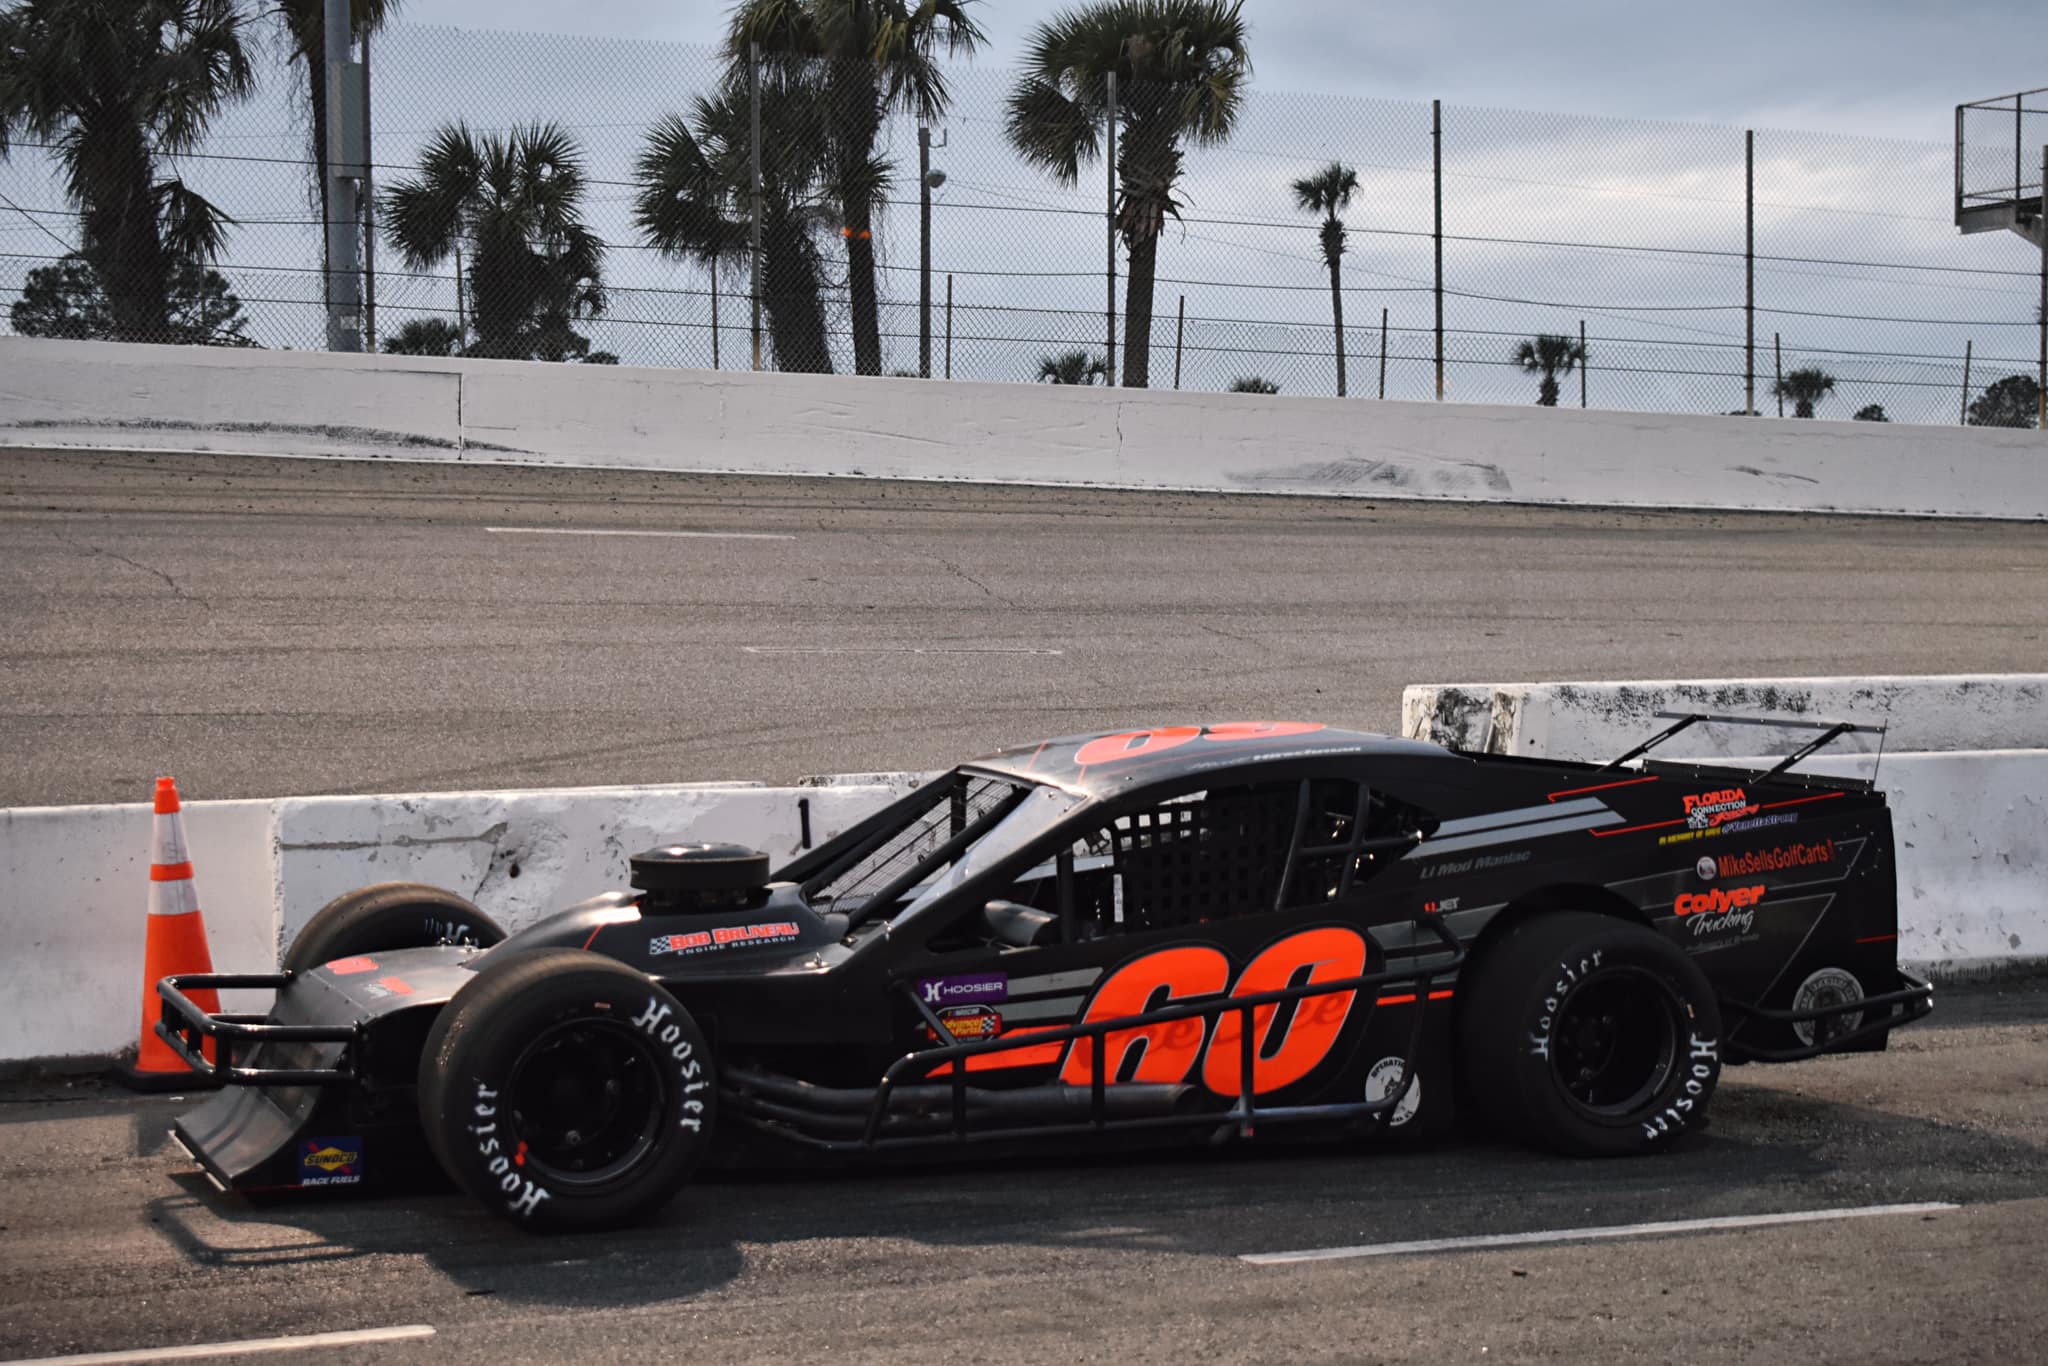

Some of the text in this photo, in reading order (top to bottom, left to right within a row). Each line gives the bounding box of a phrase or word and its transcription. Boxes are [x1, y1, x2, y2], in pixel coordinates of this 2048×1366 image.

[1682, 787, 1746, 814] FLORIDA
[1691, 800, 1747, 816] CONNECTION
[1674, 884, 1766, 917] Colyer
[1686, 905, 1755, 937] Trucking
[670, 932, 711, 951] BOB
[677, 935, 796, 956] ENGINE RESEARCH
[943, 982, 1003, 994] HOOSIER
[1058, 926, 1368, 1098] 60
[1529, 949, 1603, 1061] Hoosier
[632, 996, 710, 1133] Hoosier
[1641, 1031, 1718, 1140] Hoosier
[304, 1152, 357, 1166] SUNOCO
[466, 1083, 552, 1216] Hoosier
[330, 1175, 361, 1184] FUELS
